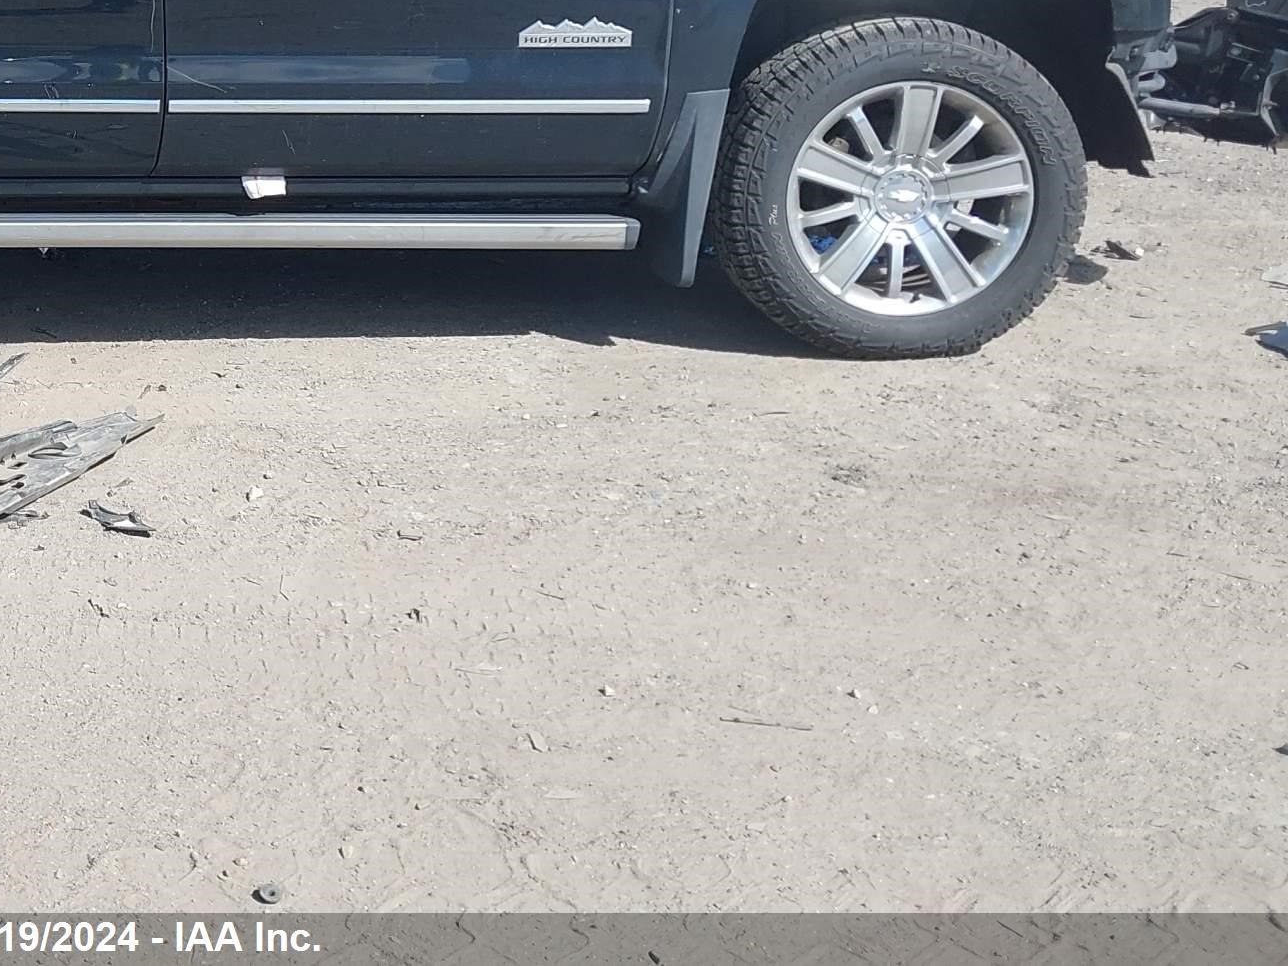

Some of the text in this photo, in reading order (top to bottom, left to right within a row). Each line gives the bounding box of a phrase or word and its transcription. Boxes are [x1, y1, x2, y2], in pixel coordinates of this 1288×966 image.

[524, 35, 626, 44] HIGH COUNTRY
[945, 65, 1057, 166] SCORPION
